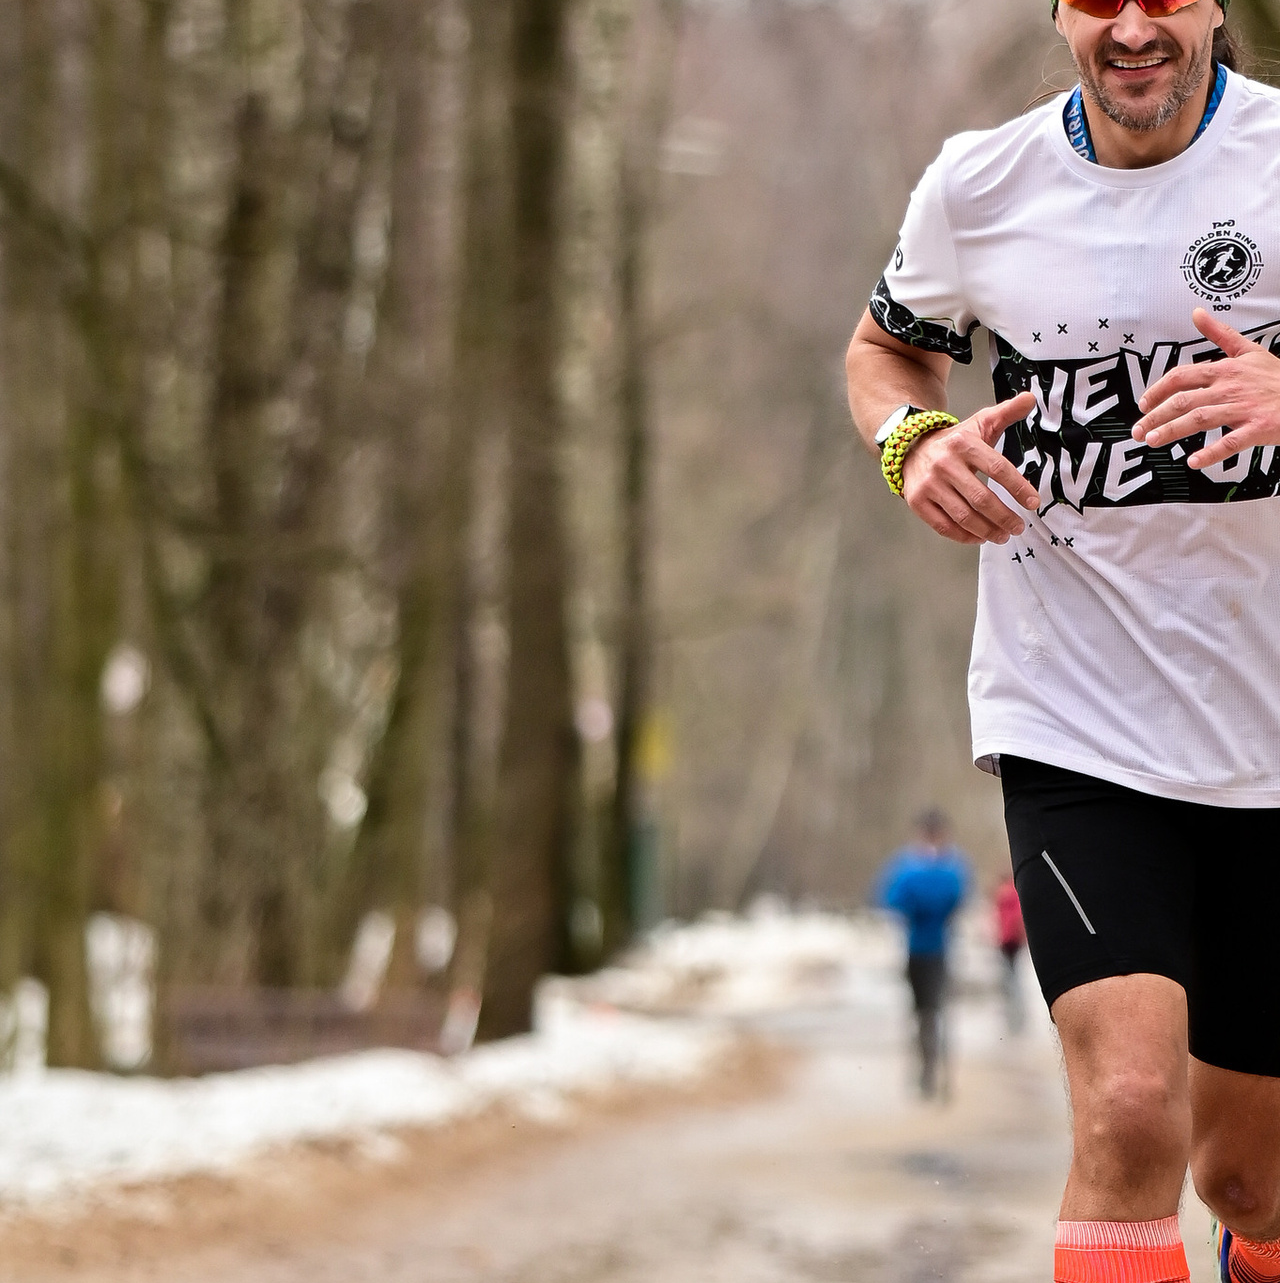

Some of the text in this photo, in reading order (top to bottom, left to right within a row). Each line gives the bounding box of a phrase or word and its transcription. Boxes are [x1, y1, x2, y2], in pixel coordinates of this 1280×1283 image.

[1189, 230, 1257, 252] GOLDEN RING
[1189, 281, 1256, 302] ULTRA TRAIL
